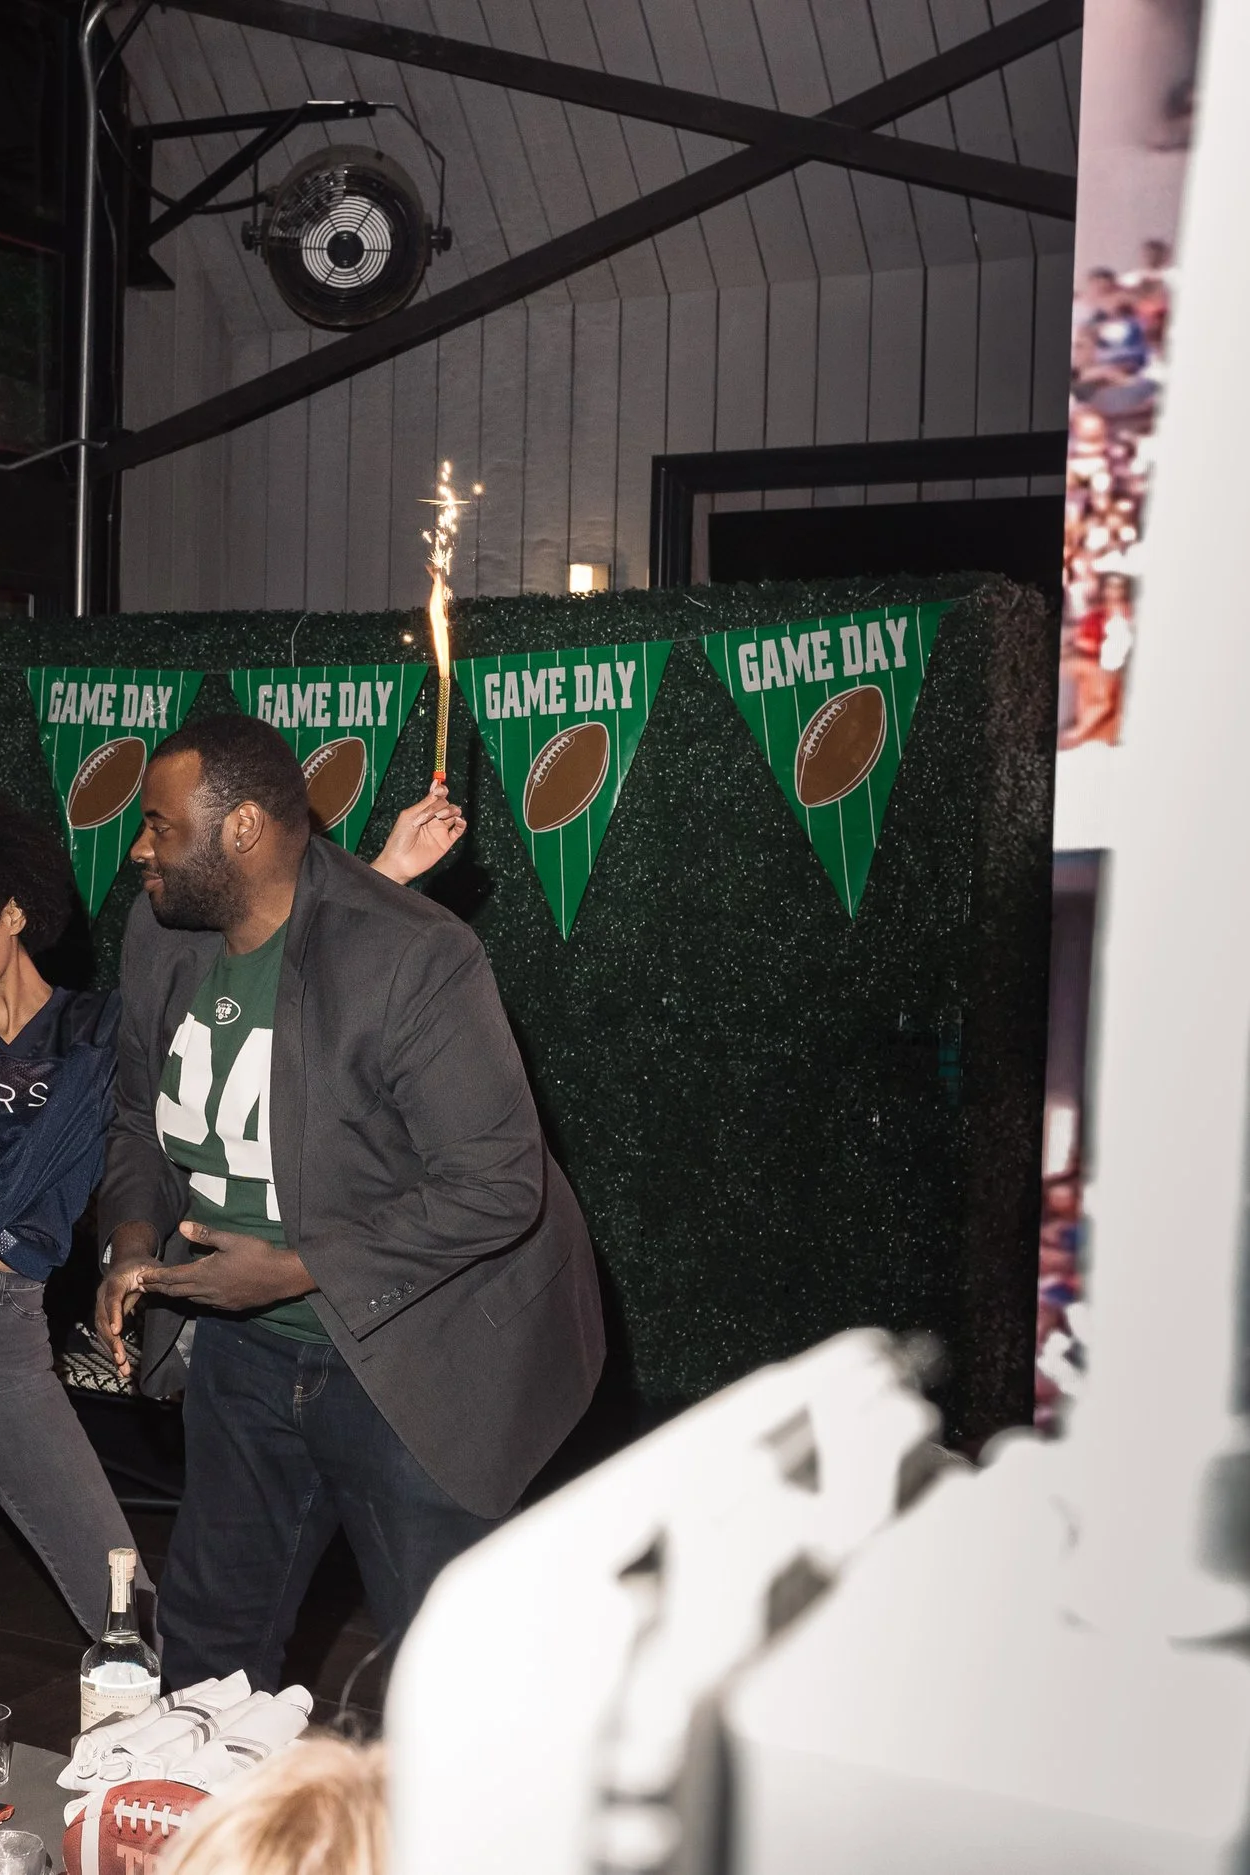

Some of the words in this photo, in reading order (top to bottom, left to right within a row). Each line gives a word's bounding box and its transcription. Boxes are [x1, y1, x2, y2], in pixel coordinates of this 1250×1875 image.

[738, 629, 834, 692] GAME
[840, 616, 908, 677] DAY
[48, 682, 117, 726] GAME
[121, 684, 173, 729] DAY
[257, 683, 331, 728] GAME
[337, 681, 394, 727] DAY
[485, 667, 567, 720] GAME
[574, 661, 636, 712] DAY
